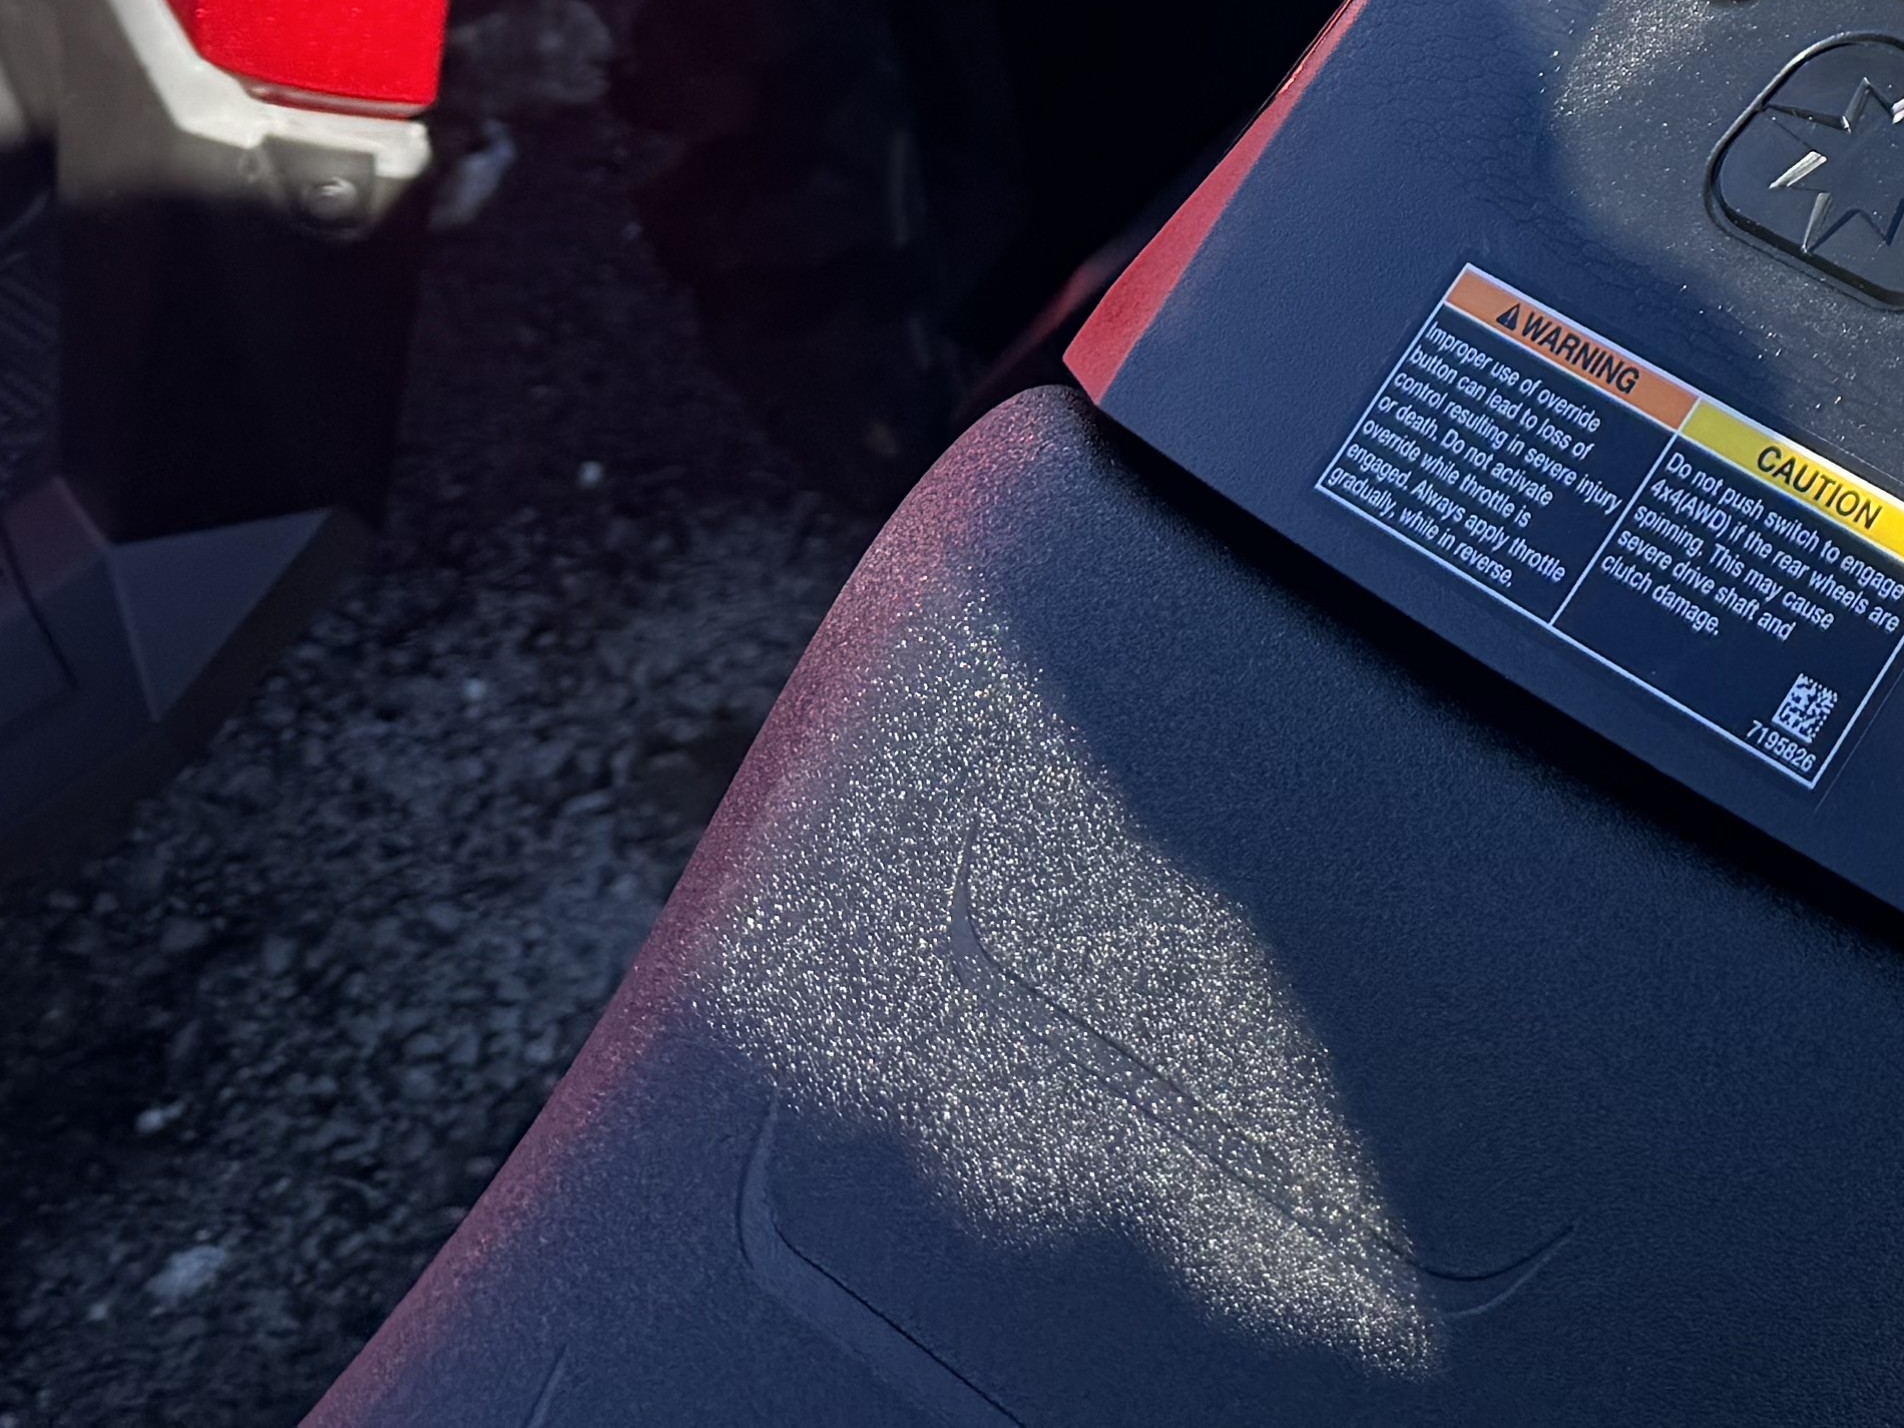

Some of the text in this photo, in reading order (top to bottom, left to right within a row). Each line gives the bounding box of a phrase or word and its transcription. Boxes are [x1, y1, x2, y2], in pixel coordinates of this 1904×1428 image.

[1408, 344, 1594, 461] button can lead to loss of
[1423, 321, 1605, 433] Improper use of override
[1517, 311, 1643, 395] WARNING
[1360, 414, 1535, 528] override while throttle is
[1376, 395, 1557, 507] or death. Do not activate
[1391, 367, 1625, 516] control resulting in severe injury
[1752, 443, 1883, 530] CAUTION
[1325, 462, 1517, 587] gradually, while in reverse.
[1342, 439, 1569, 583] engaged. Always apply throttle
[1645, 475, 1901, 633] 4x4(AWD) if the rear wheels are
[1665, 451, 1696, 480] Do
[1691, 467, 1724, 496] not
[1717, 482, 1768, 524] push
[1762, 506, 1823, 552] switch
[1817, 539, 1843, 564] to
[1599, 550, 1727, 638] clutch damage.
[1616, 529, 1796, 641] severe drive shaft and
[1630, 501, 1835, 630] spinning. This may cause
[1744, 719, 1817, 773] 7195826
